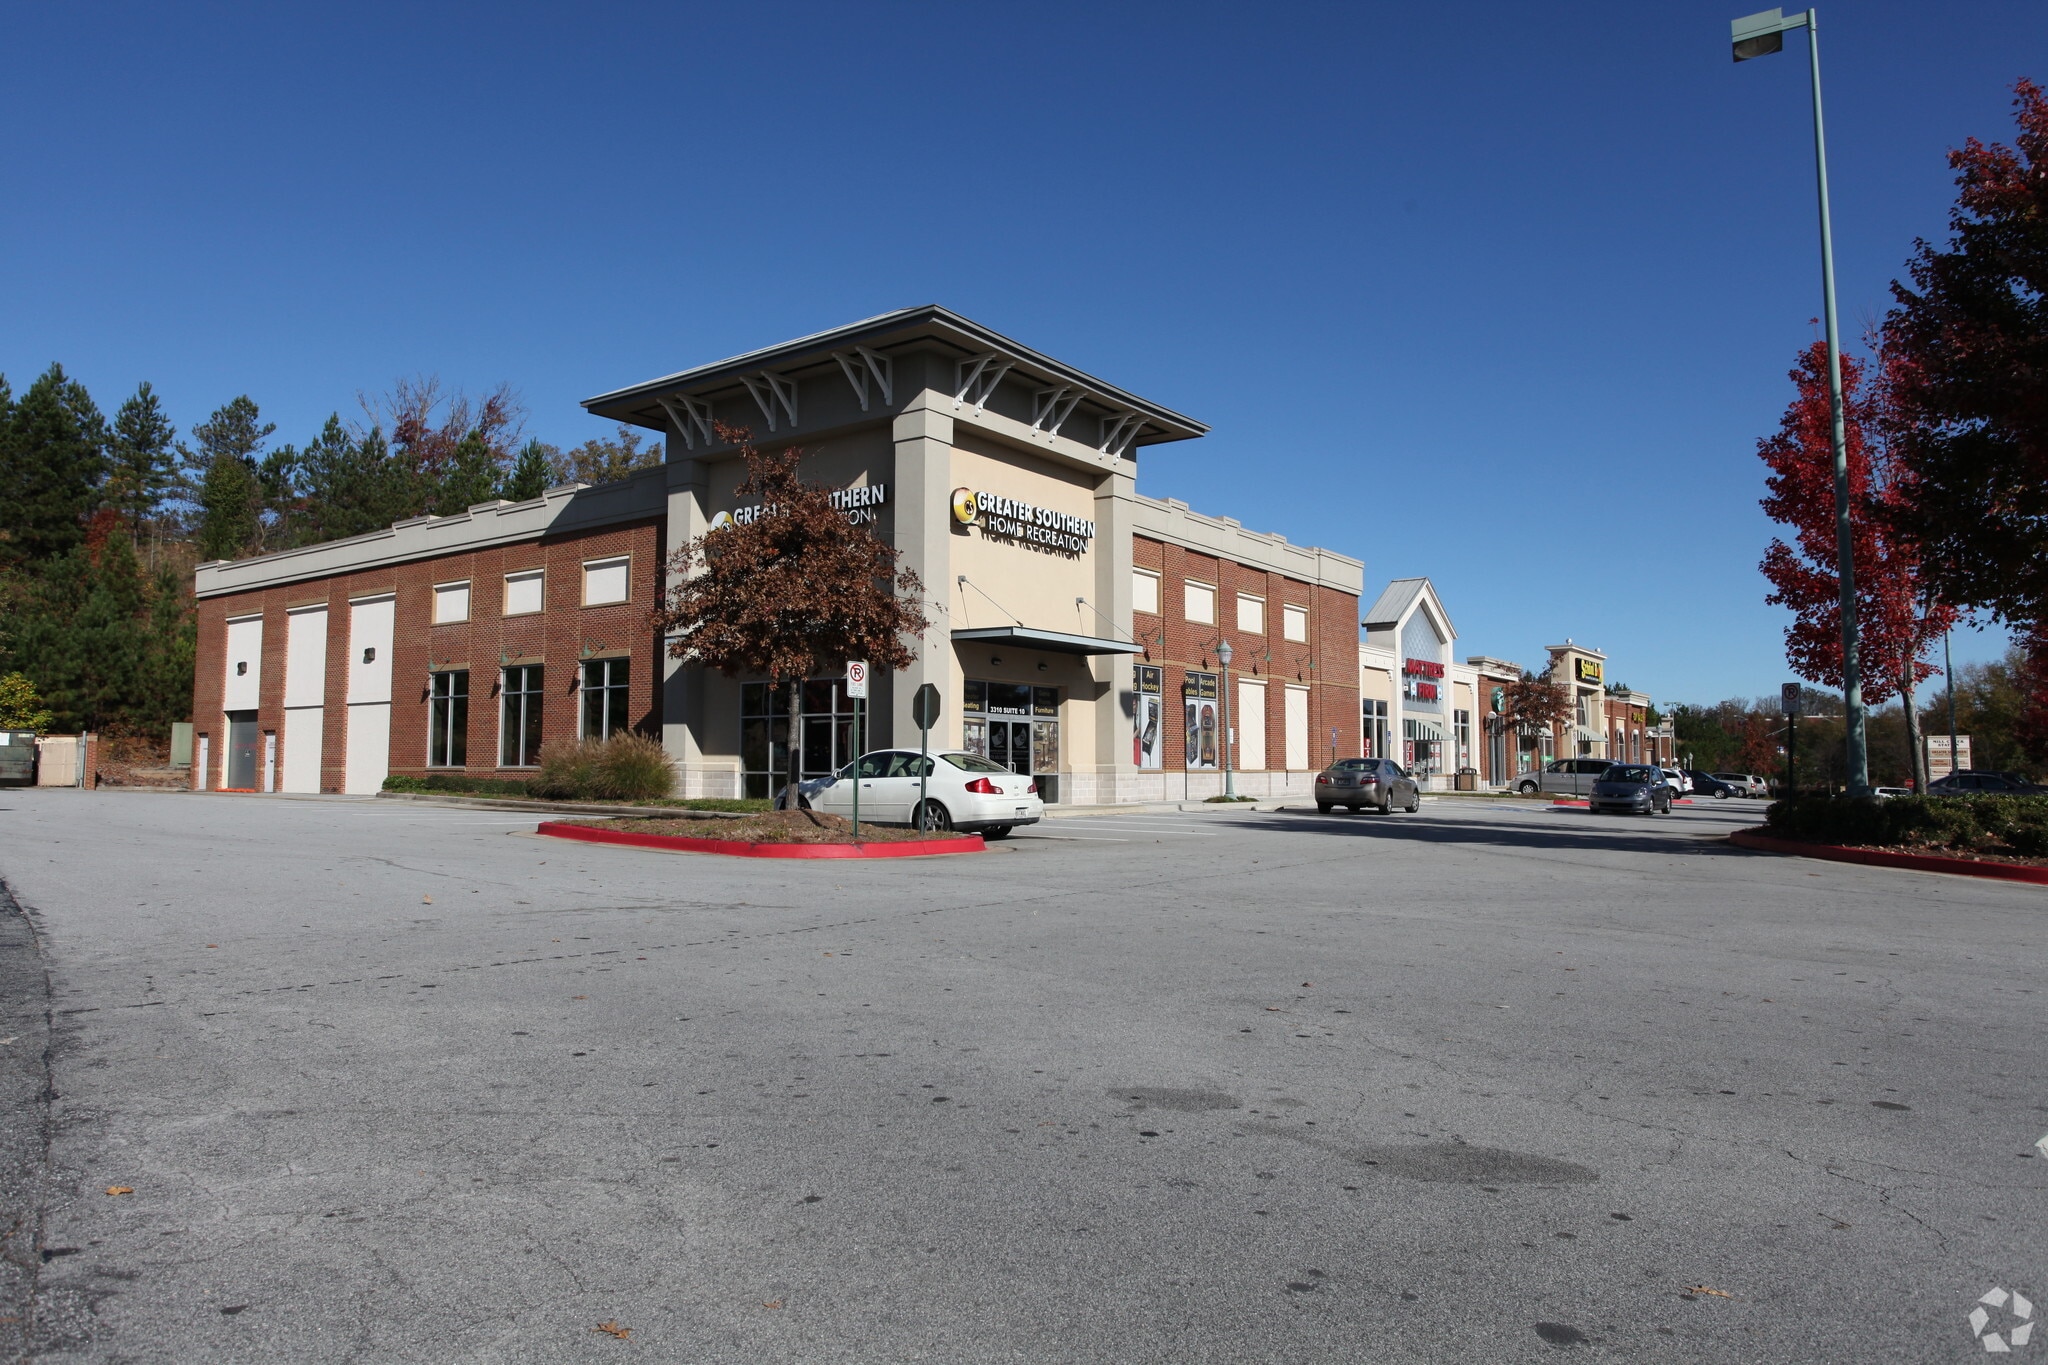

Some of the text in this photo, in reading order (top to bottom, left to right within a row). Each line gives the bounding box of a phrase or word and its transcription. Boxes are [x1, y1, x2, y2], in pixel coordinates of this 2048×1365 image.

[977, 491, 1096, 538] GREATER SOUTHERN
[989, 515, 1088, 552] HOME RECREATION
[1406, 658, 1444, 678] MATTRESS
[1146, 670, 1154, 679] Air
[1185, 676, 1195, 684] Pool
[1200, 678, 1215, 687] Arcade
[1200, 689, 1215, 697] Games
[1417, 682, 1438, 700] FIRM
[990, 706, 1002, 714] 3310
[1003, 707, 1018, 715] SUITE
